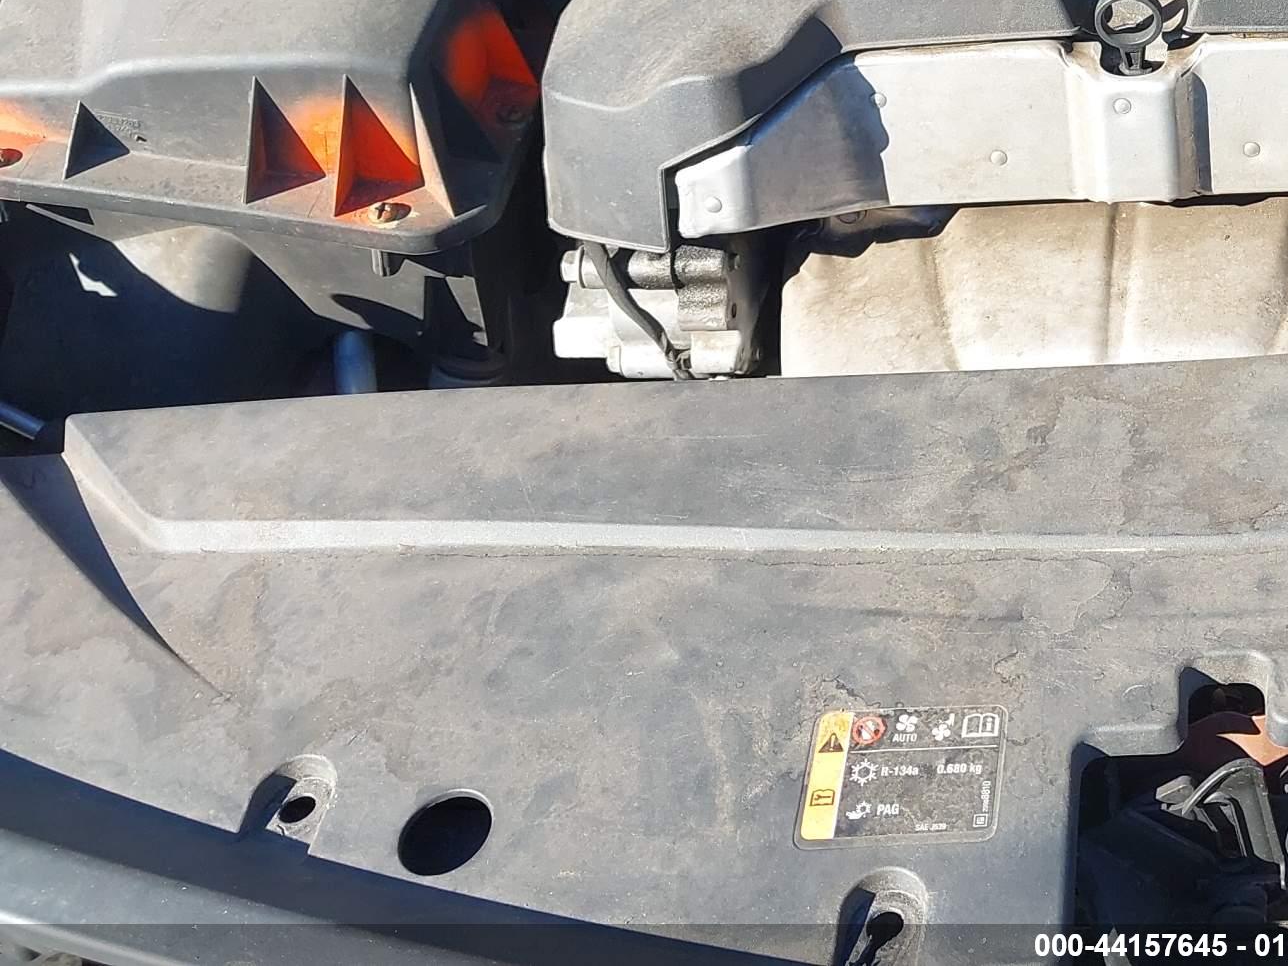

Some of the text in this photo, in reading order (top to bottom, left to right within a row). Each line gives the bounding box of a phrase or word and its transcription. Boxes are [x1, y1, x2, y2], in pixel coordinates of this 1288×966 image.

[892, 733, 917, 742] AUTO
[880, 763, 982, 776] R-134a 0.680 kg
[876, 804, 900, 815] PAG
